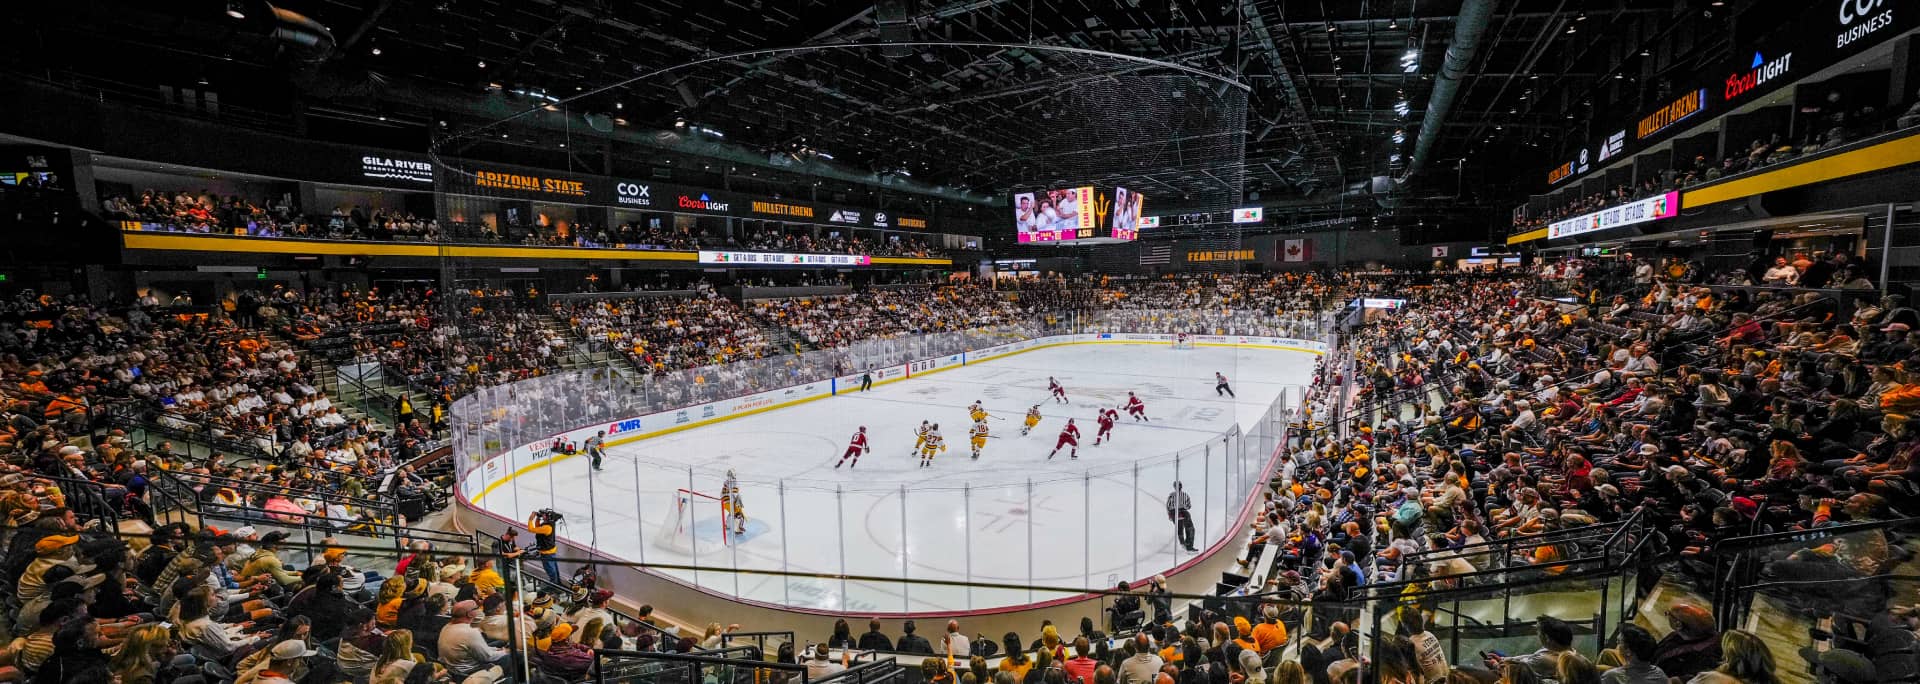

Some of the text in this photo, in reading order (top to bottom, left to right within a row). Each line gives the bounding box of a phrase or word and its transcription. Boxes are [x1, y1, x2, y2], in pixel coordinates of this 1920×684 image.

[1839, 0, 1883, 24] CO
[1837, 9, 1892, 48] BUSINESS
[1725, 52, 1792, 100] Coors LIGHT
[1637, 89, 1698, 139] MULLETT ARENA
[362, 156, 431, 171] GILA RIVER
[476, 170, 585, 196] ARIZONA STATE
[617, 182, 650, 197] COX
[618, 197, 650, 206] BUSINESS
[679, 195, 729, 211] Coors LIGHT
[752, 201, 814, 217] MULLETT ARENA
[1078, 229, 1092, 237] ASU
[1187, 251, 1213, 262] FEAR
[1227, 250, 1255, 260] FORK
[608, 419, 641, 434] AMR
[927, 434, 938, 444] 27
